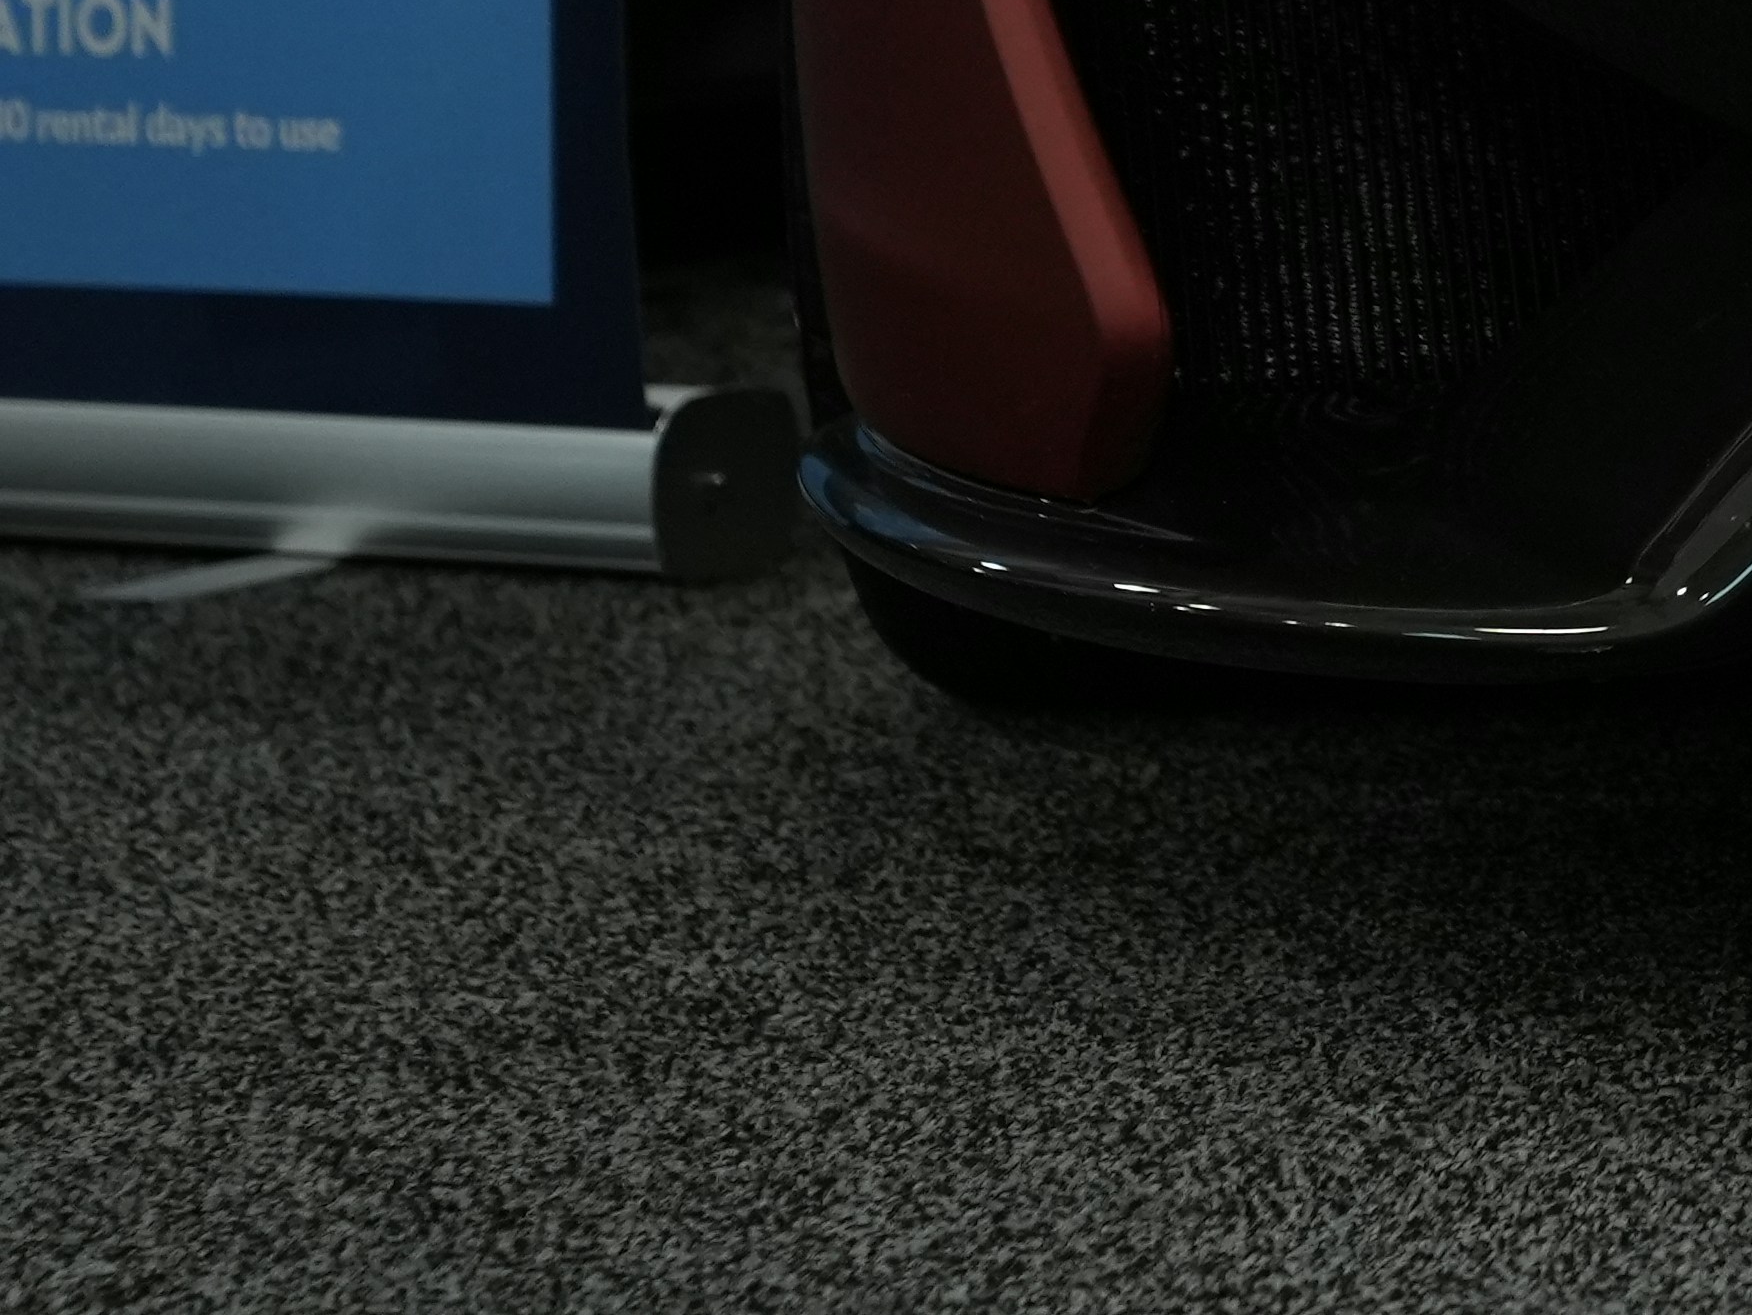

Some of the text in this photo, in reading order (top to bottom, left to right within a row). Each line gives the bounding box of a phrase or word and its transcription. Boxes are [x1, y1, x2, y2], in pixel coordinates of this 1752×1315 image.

[36, 103, 139, 147] rental
[145, 102, 228, 156] days
[233, 111, 274, 149] to
[278, 117, 343, 152] use
